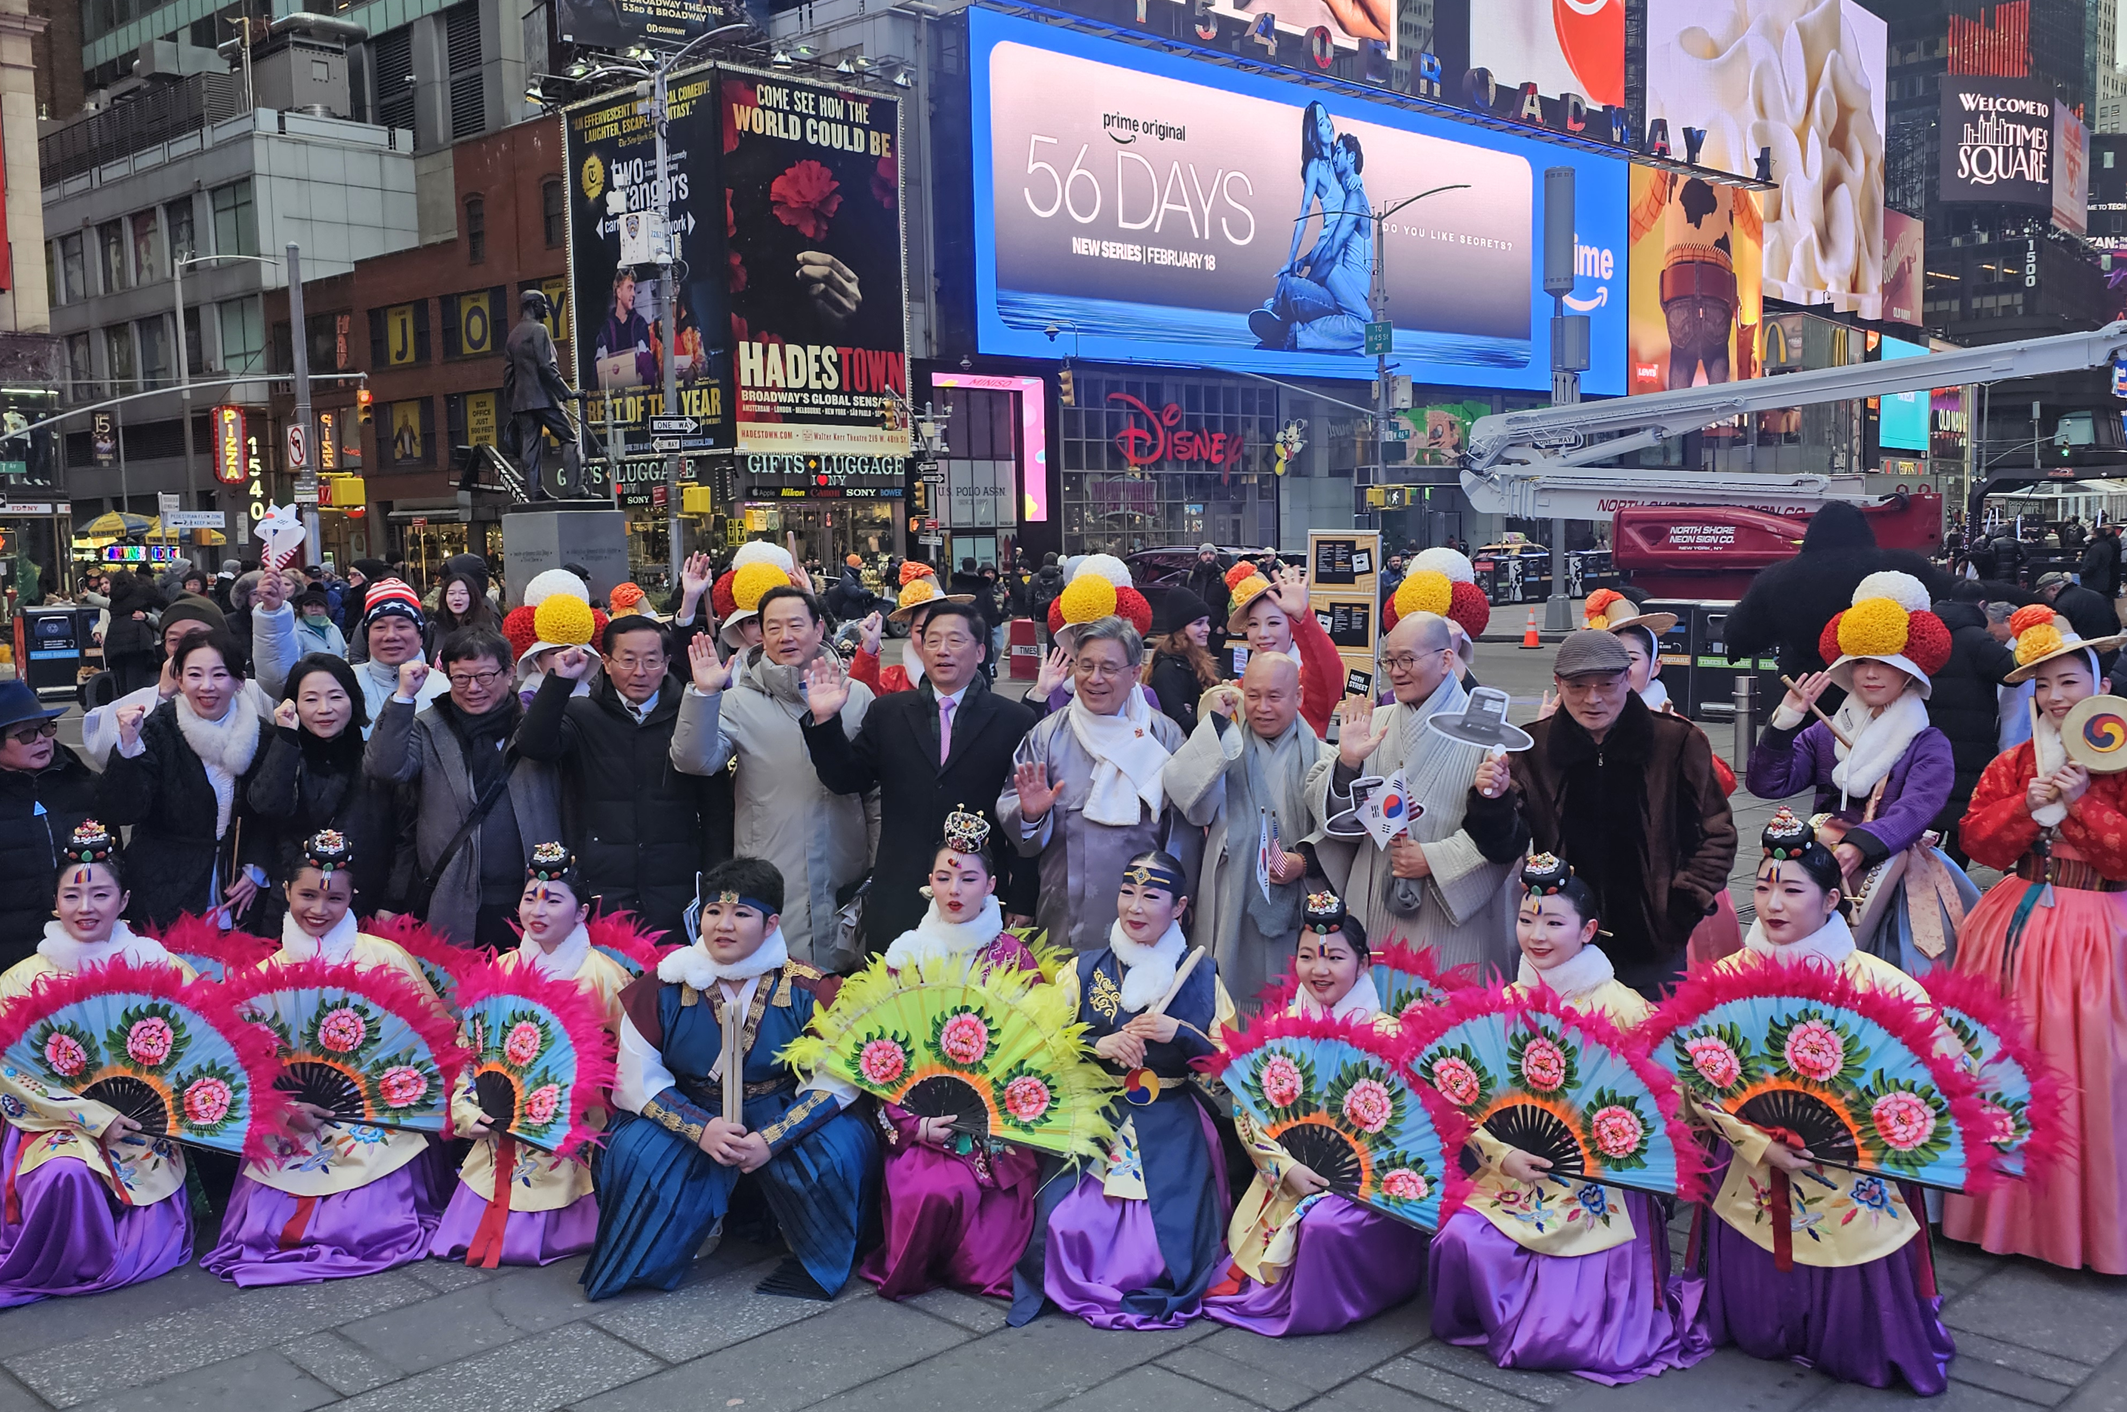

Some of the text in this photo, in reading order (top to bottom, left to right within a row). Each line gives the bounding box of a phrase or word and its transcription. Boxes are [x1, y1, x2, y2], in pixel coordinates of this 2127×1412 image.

[656, 7, 707, 22] BROADWAY
[683, 1, 724, 15] THEATRE
[658, 26, 686, 36] COMPANY
[678, 80, 710, 102] COMEDY!
[756, 83, 870, 125] COME SEE HOW THE
[732, 103, 892, 158] WORLD COULD BE
[1103, 110, 1186, 142] prime original
[2005, 123, 2049, 151] TIMES
[1957, 145, 2049, 185] SQUARE
[1023, 133, 1256, 246] 56 DAYS
[2108, 203, 2127, 211] TECH
[1382, 222, 1513, 251] DO YOU LIKE SECRETS?
[1072, 236, 1216, 271] NEW SERIES FEBRUARY 18
[2025, 240, 2036, 288] 1500
[738, 340, 906, 394] HADESTOWN
[967, 378, 1013, 388] MINISO
[626, 395, 645, 422] OF
[681, 387, 721, 416] YEAR
[741, 390, 851, 406] BROADWAY'S GLOBAL
[472, 409, 491, 417] OFFICE
[742, 403, 771, 413] AMSTERDAM
[773, 405, 793, 414] LONDON
[825, 407, 834, 415] NEW
[835, 408, 847, 416] YORK
[94, 416, 111, 433] 15
[475, 418, 489, 426] JUST
[657, 421, 673, 429] ONE
[678, 421, 693, 429] WAY
[1938, 408, 1950, 432] OLD
[741, 429, 793, 440] HADESTOWN.COM
[814, 430, 832, 440] Walter
[833, 432, 845, 441] Kerr
[845, 432, 868, 441] Theatre
[223, 409, 240, 480] PIZZA
[667, 440, 678, 448] WAY
[616, 459, 697, 483] LUGGAE
[747, 455, 906, 476] GIFTS LUGGAGE
[247, 436, 265, 521] 1540
[627, 496, 649, 504] SONY
[758, 489, 776, 498] Apple
[780, 488, 806, 497] Nikon
[810, 488, 840, 498] Canon
[846, 489, 876, 497] SONY
[938, 486, 1007, 497] U.S. POLO ASSN.
[737, 520, 745, 542] ATM
[1670, 526, 1736, 534] NORTH SHORE
[1669, 535, 1735, 544] NEON SIGN CO.
[1020, 646, 1037, 656] TIMES
